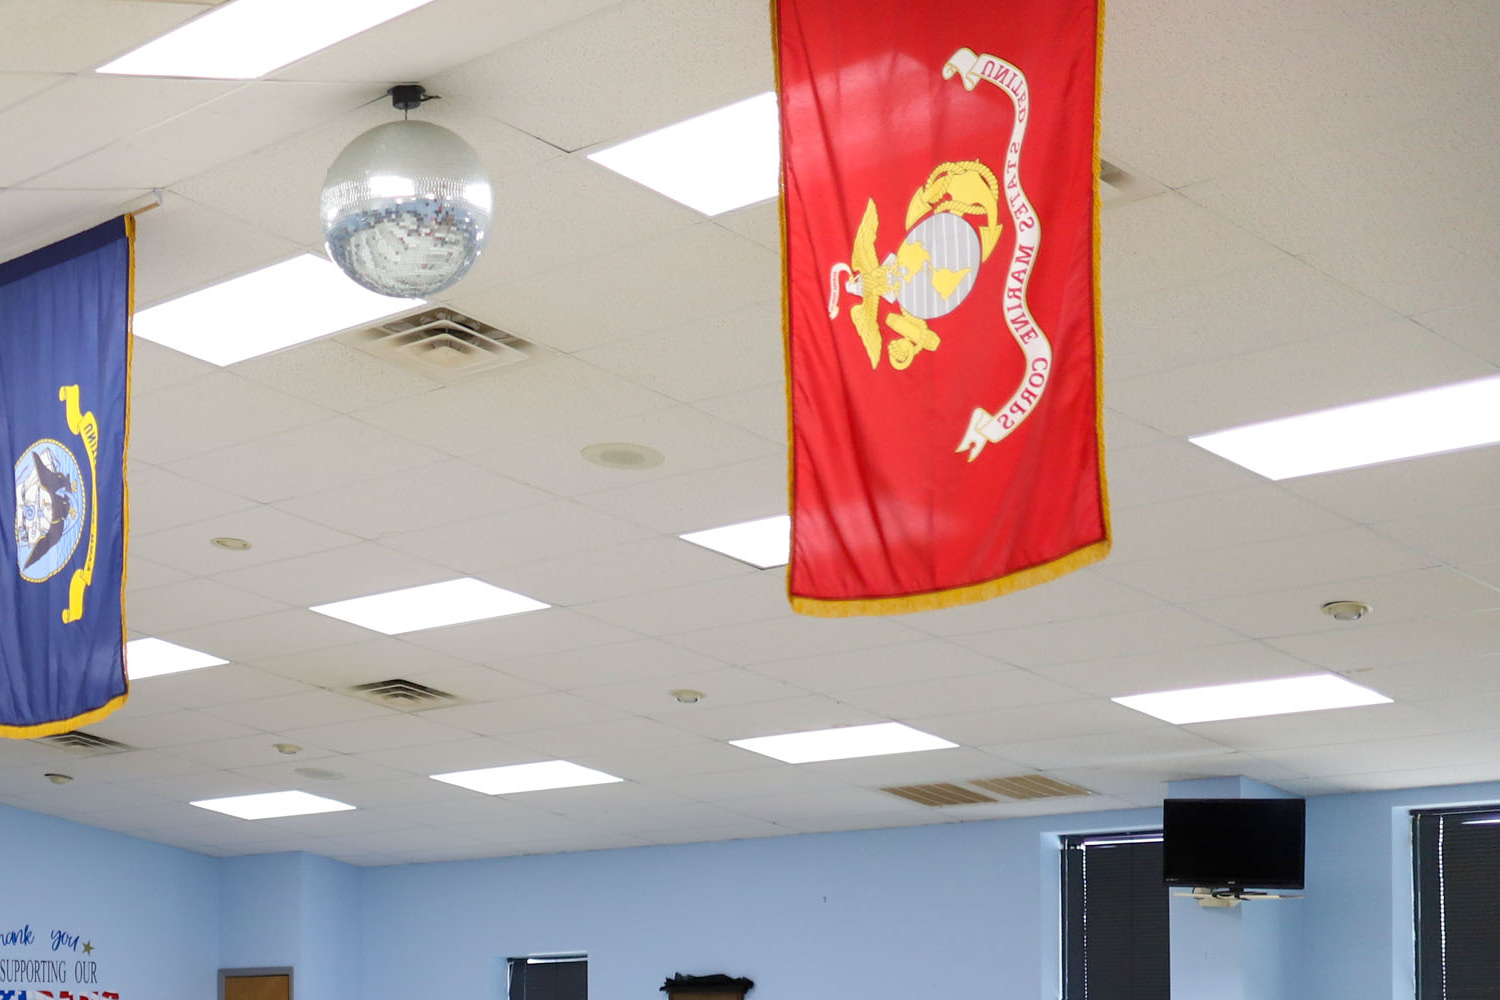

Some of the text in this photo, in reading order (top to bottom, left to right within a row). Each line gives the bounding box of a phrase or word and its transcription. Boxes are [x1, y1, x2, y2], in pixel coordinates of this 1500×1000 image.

[50, 929, 80, 952] you
[0, 959, 67, 984] SUPPORTING
[74, 961, 98, 984] OUR
